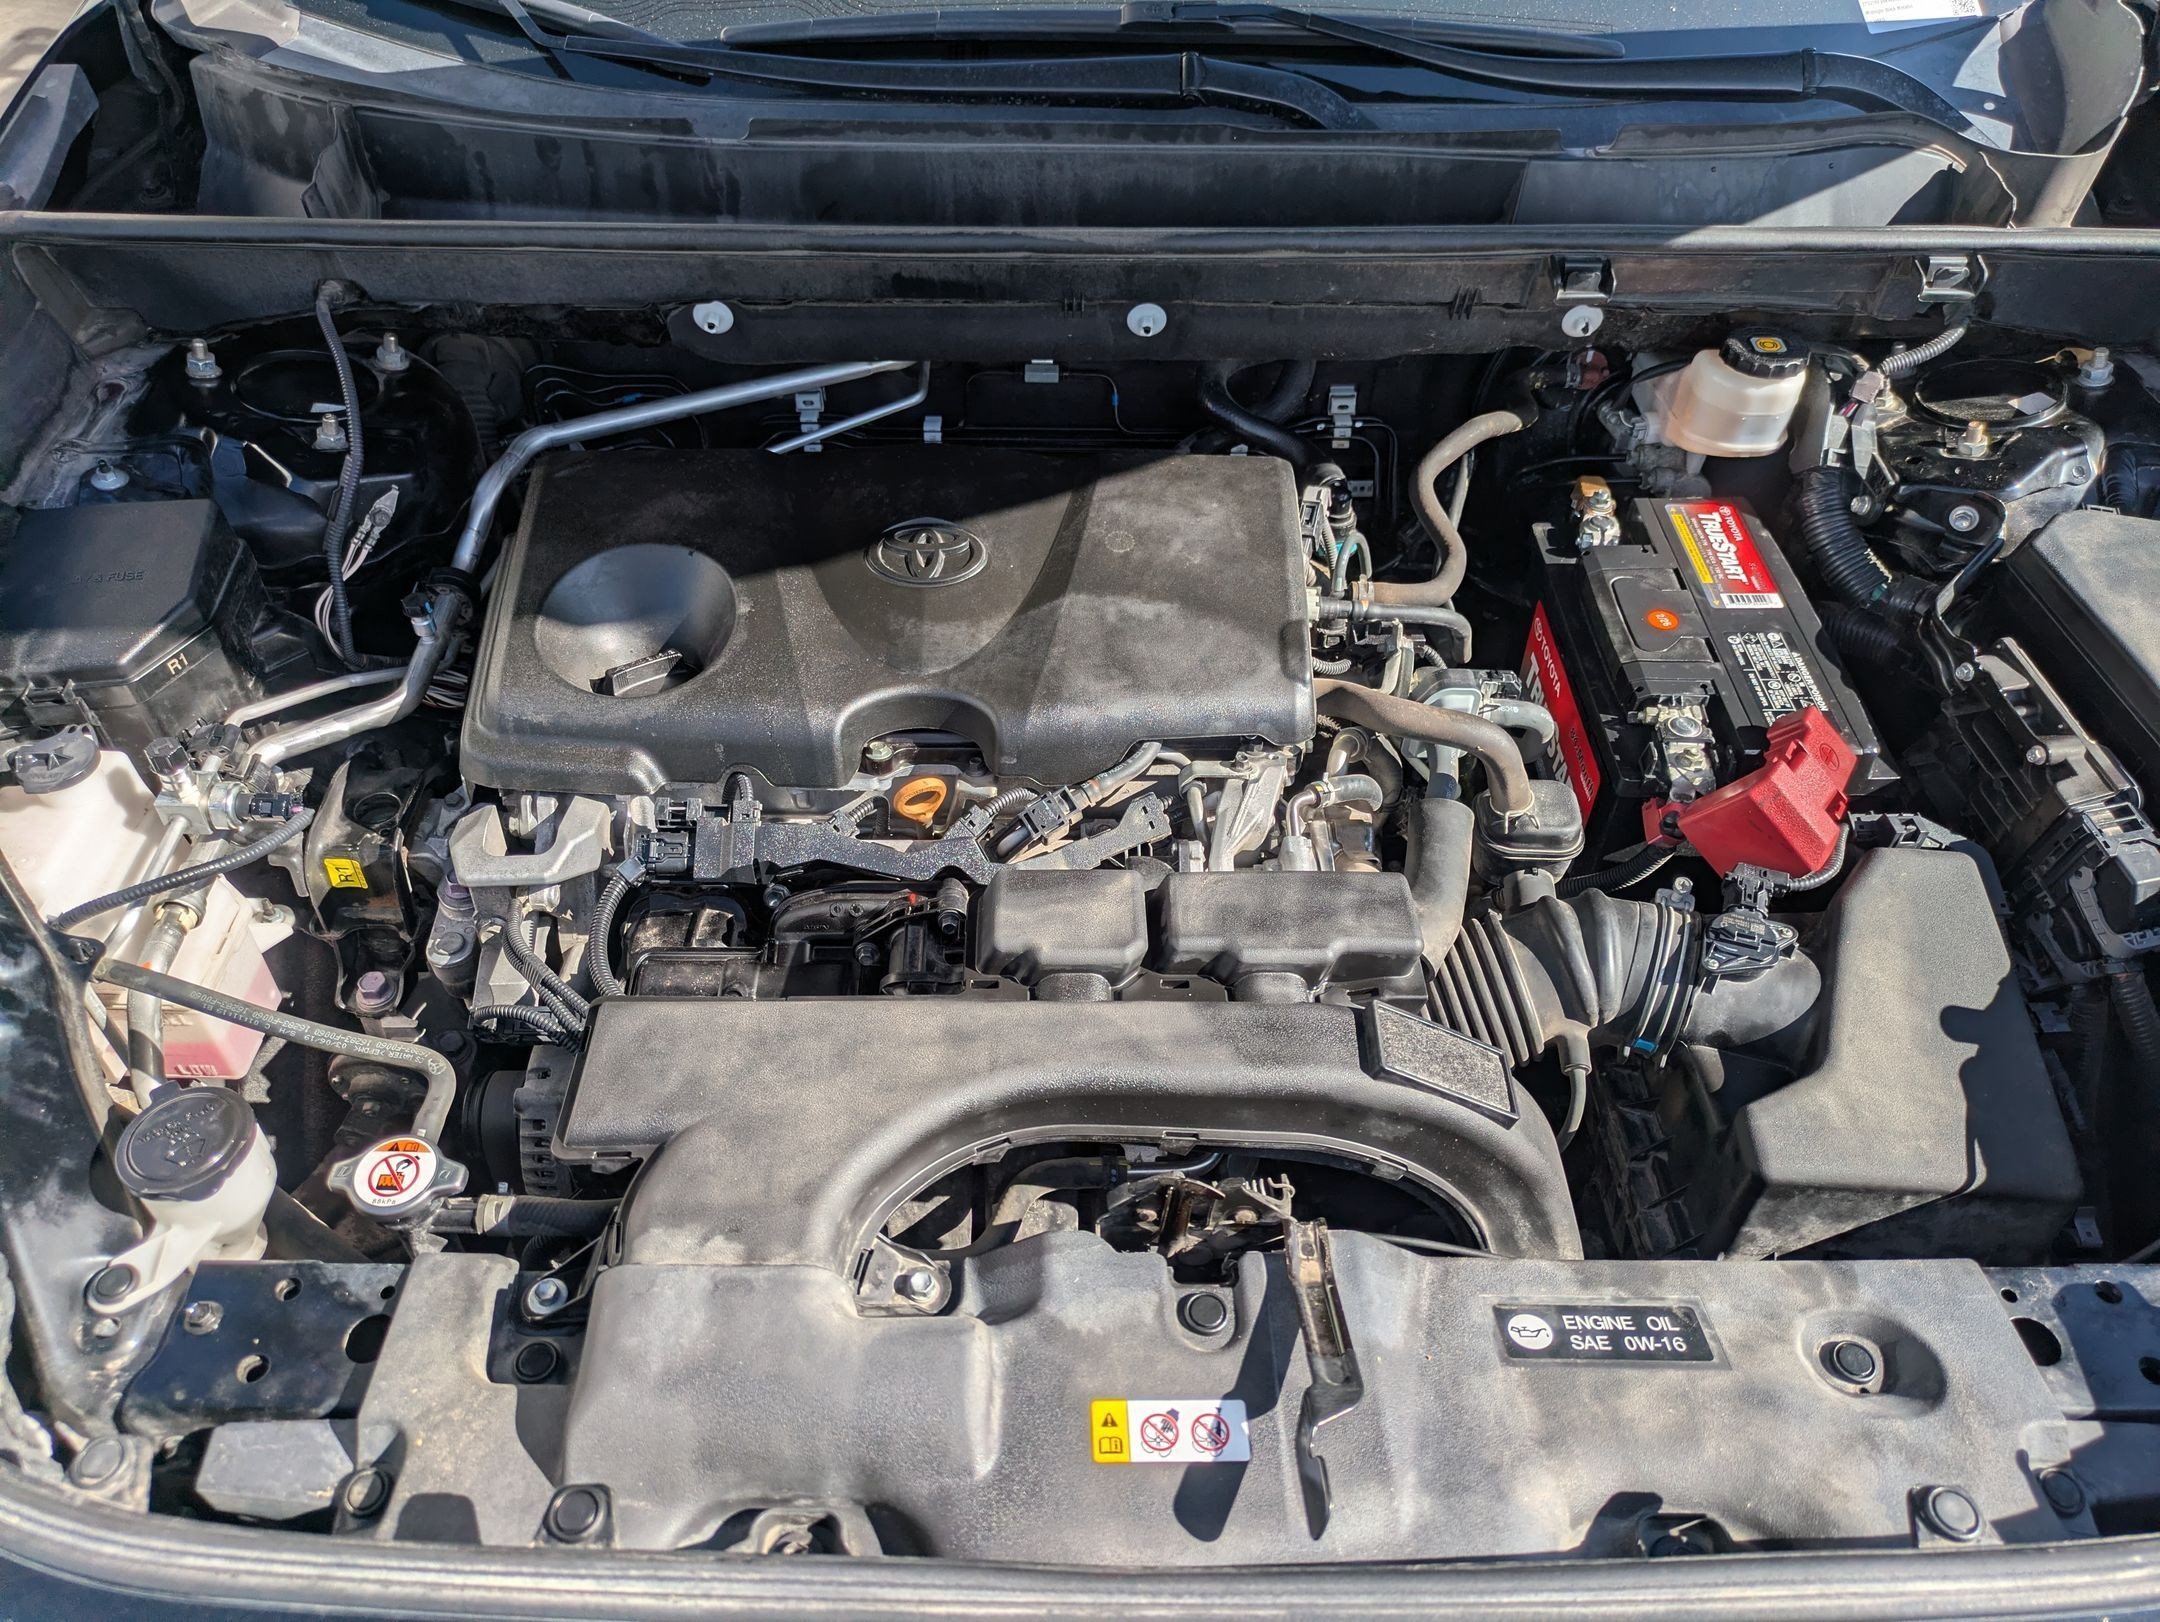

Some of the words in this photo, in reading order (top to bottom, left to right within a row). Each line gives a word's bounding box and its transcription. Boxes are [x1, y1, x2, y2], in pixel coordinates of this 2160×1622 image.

[1724, 516, 1743, 541] TOYOTA
[167, 652, 188, 675] R1
[1540, 638, 1561, 698] TOYOTA
[1795, 656, 1815, 686] DANGER
[1808, 685, 1829, 711] POISON
[335, 866, 355, 883] R1
[388, 1051, 414, 1062] WATER
[174, 1064, 218, 1076] LOW
[1562, 1315, 1636, 1331] ENGINE
[1646, 1316, 1680, 1331] OIL
[1570, 1335, 1613, 1351] SAE
[1624, 1336, 1687, 1352] 0W-16
